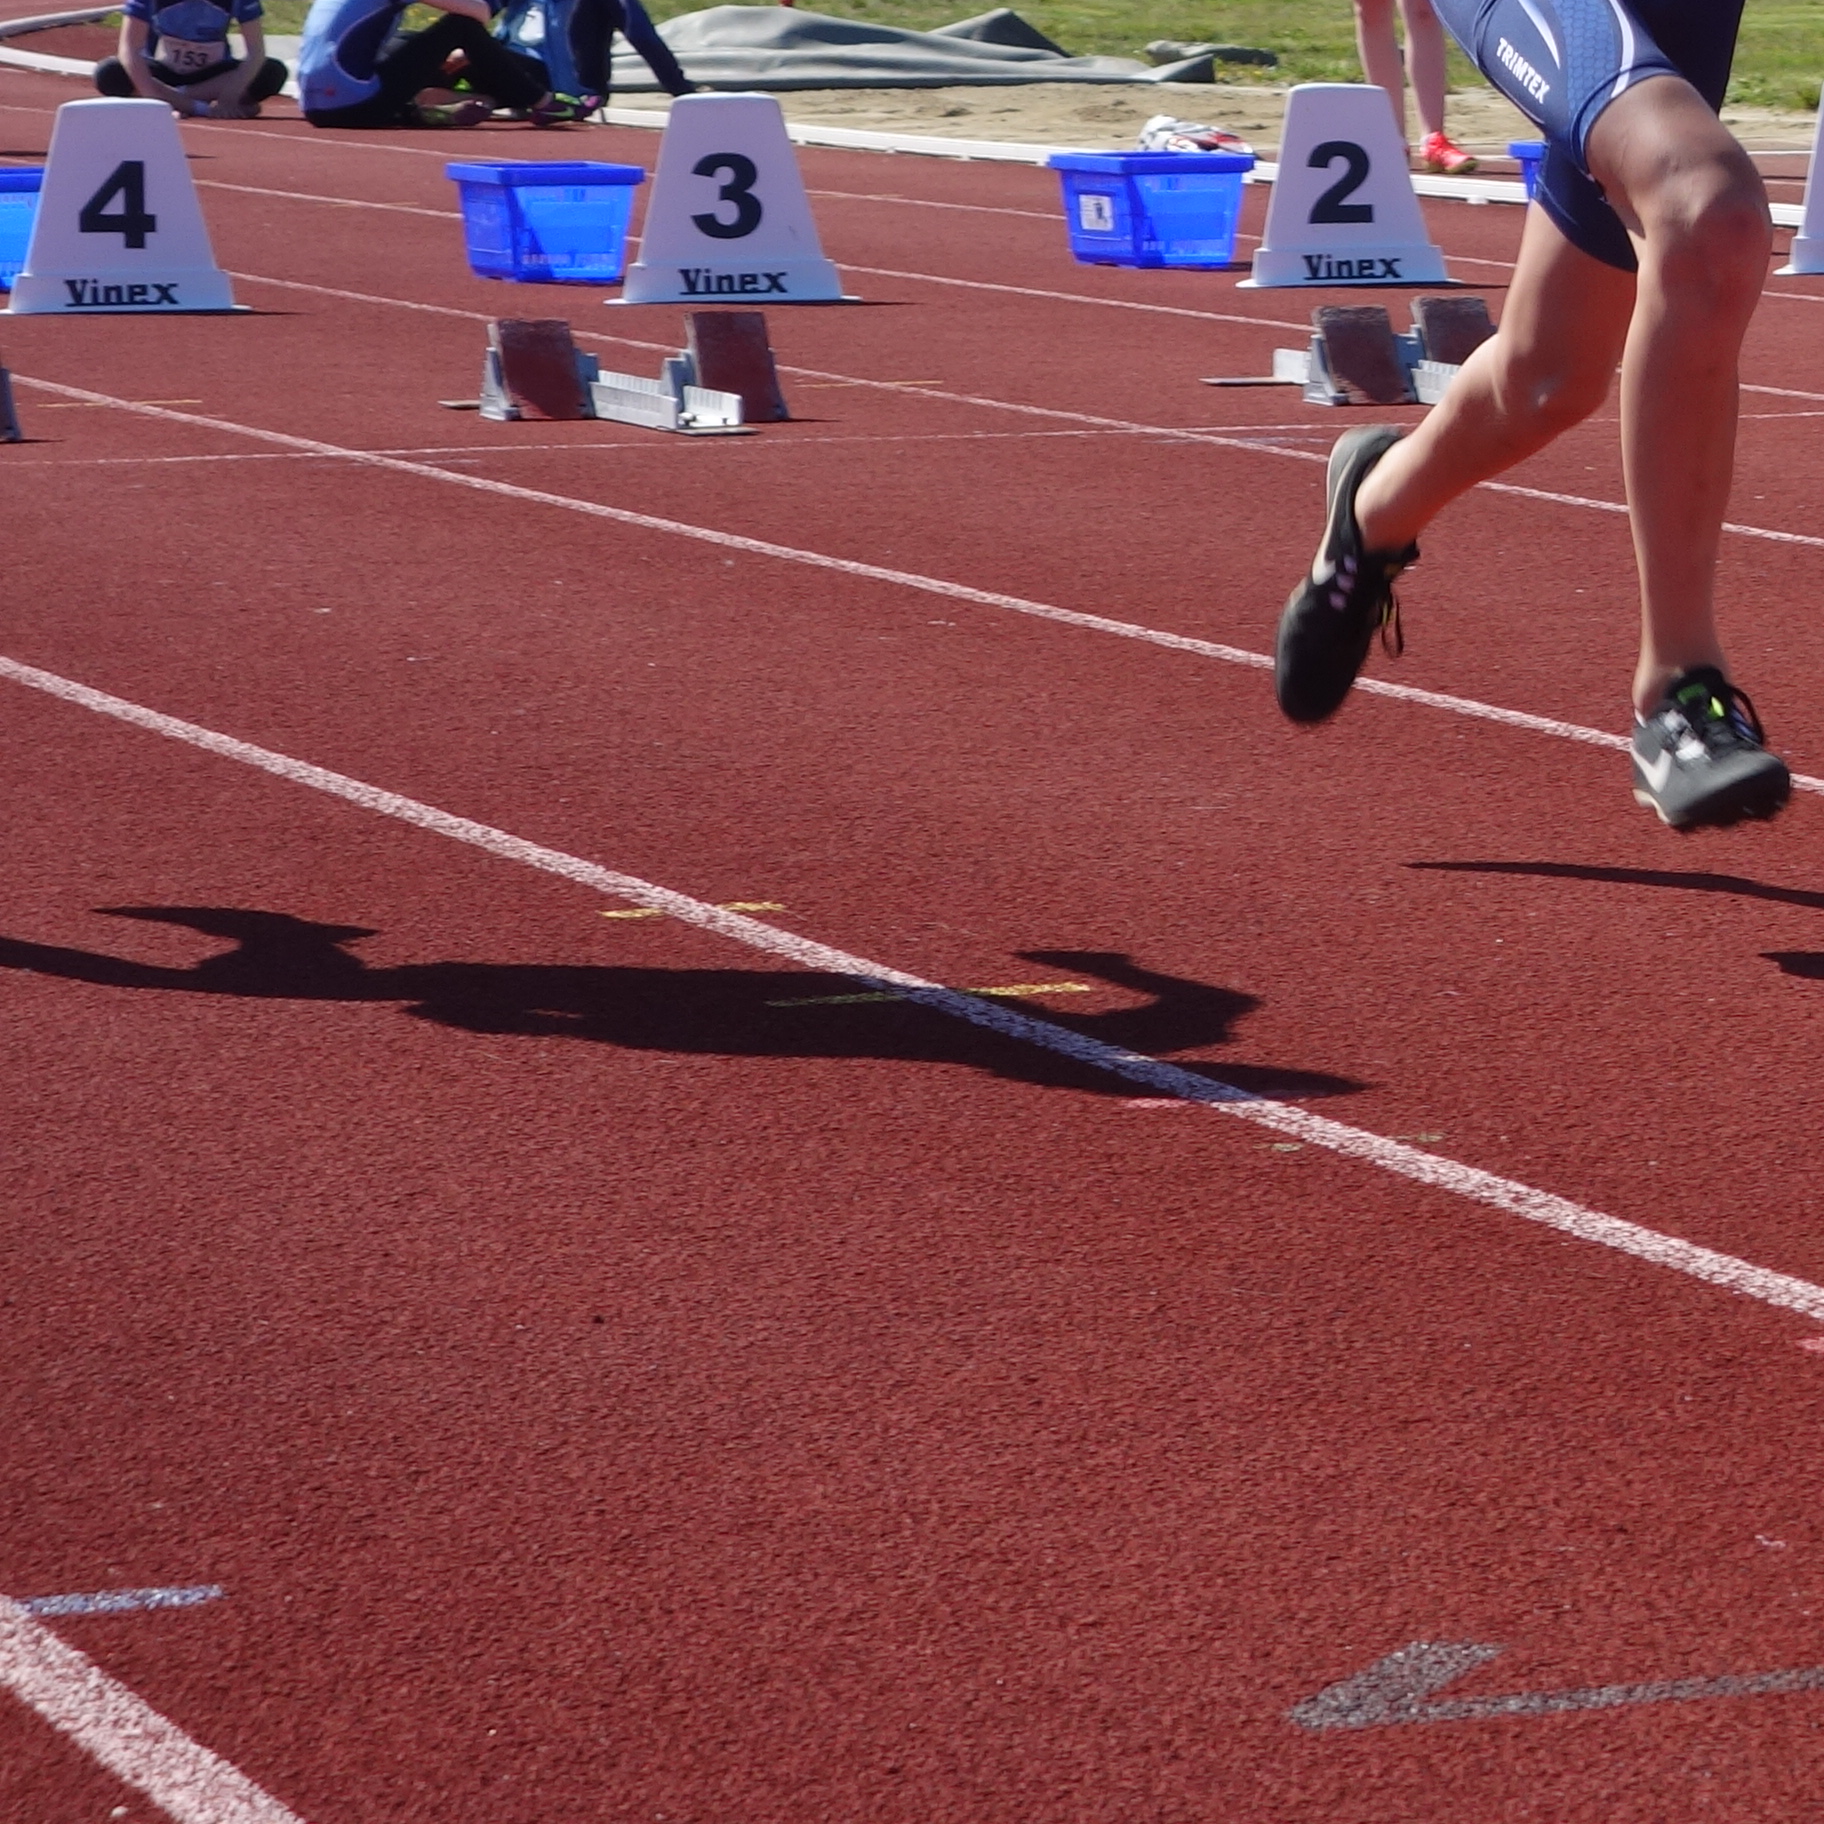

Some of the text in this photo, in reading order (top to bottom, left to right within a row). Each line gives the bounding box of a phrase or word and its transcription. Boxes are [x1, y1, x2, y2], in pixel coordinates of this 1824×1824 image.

[1496, 37, 1550, 105] TRIMTEX
[79, 160, 157, 249] 4
[690, 152, 763, 239] 3
[1307, 140, 1375, 225] 2
[63, 278, 179, 307] Vinex
[679, 268, 788, 295] Vinex
[1302, 253, 1402, 281] Vinex
